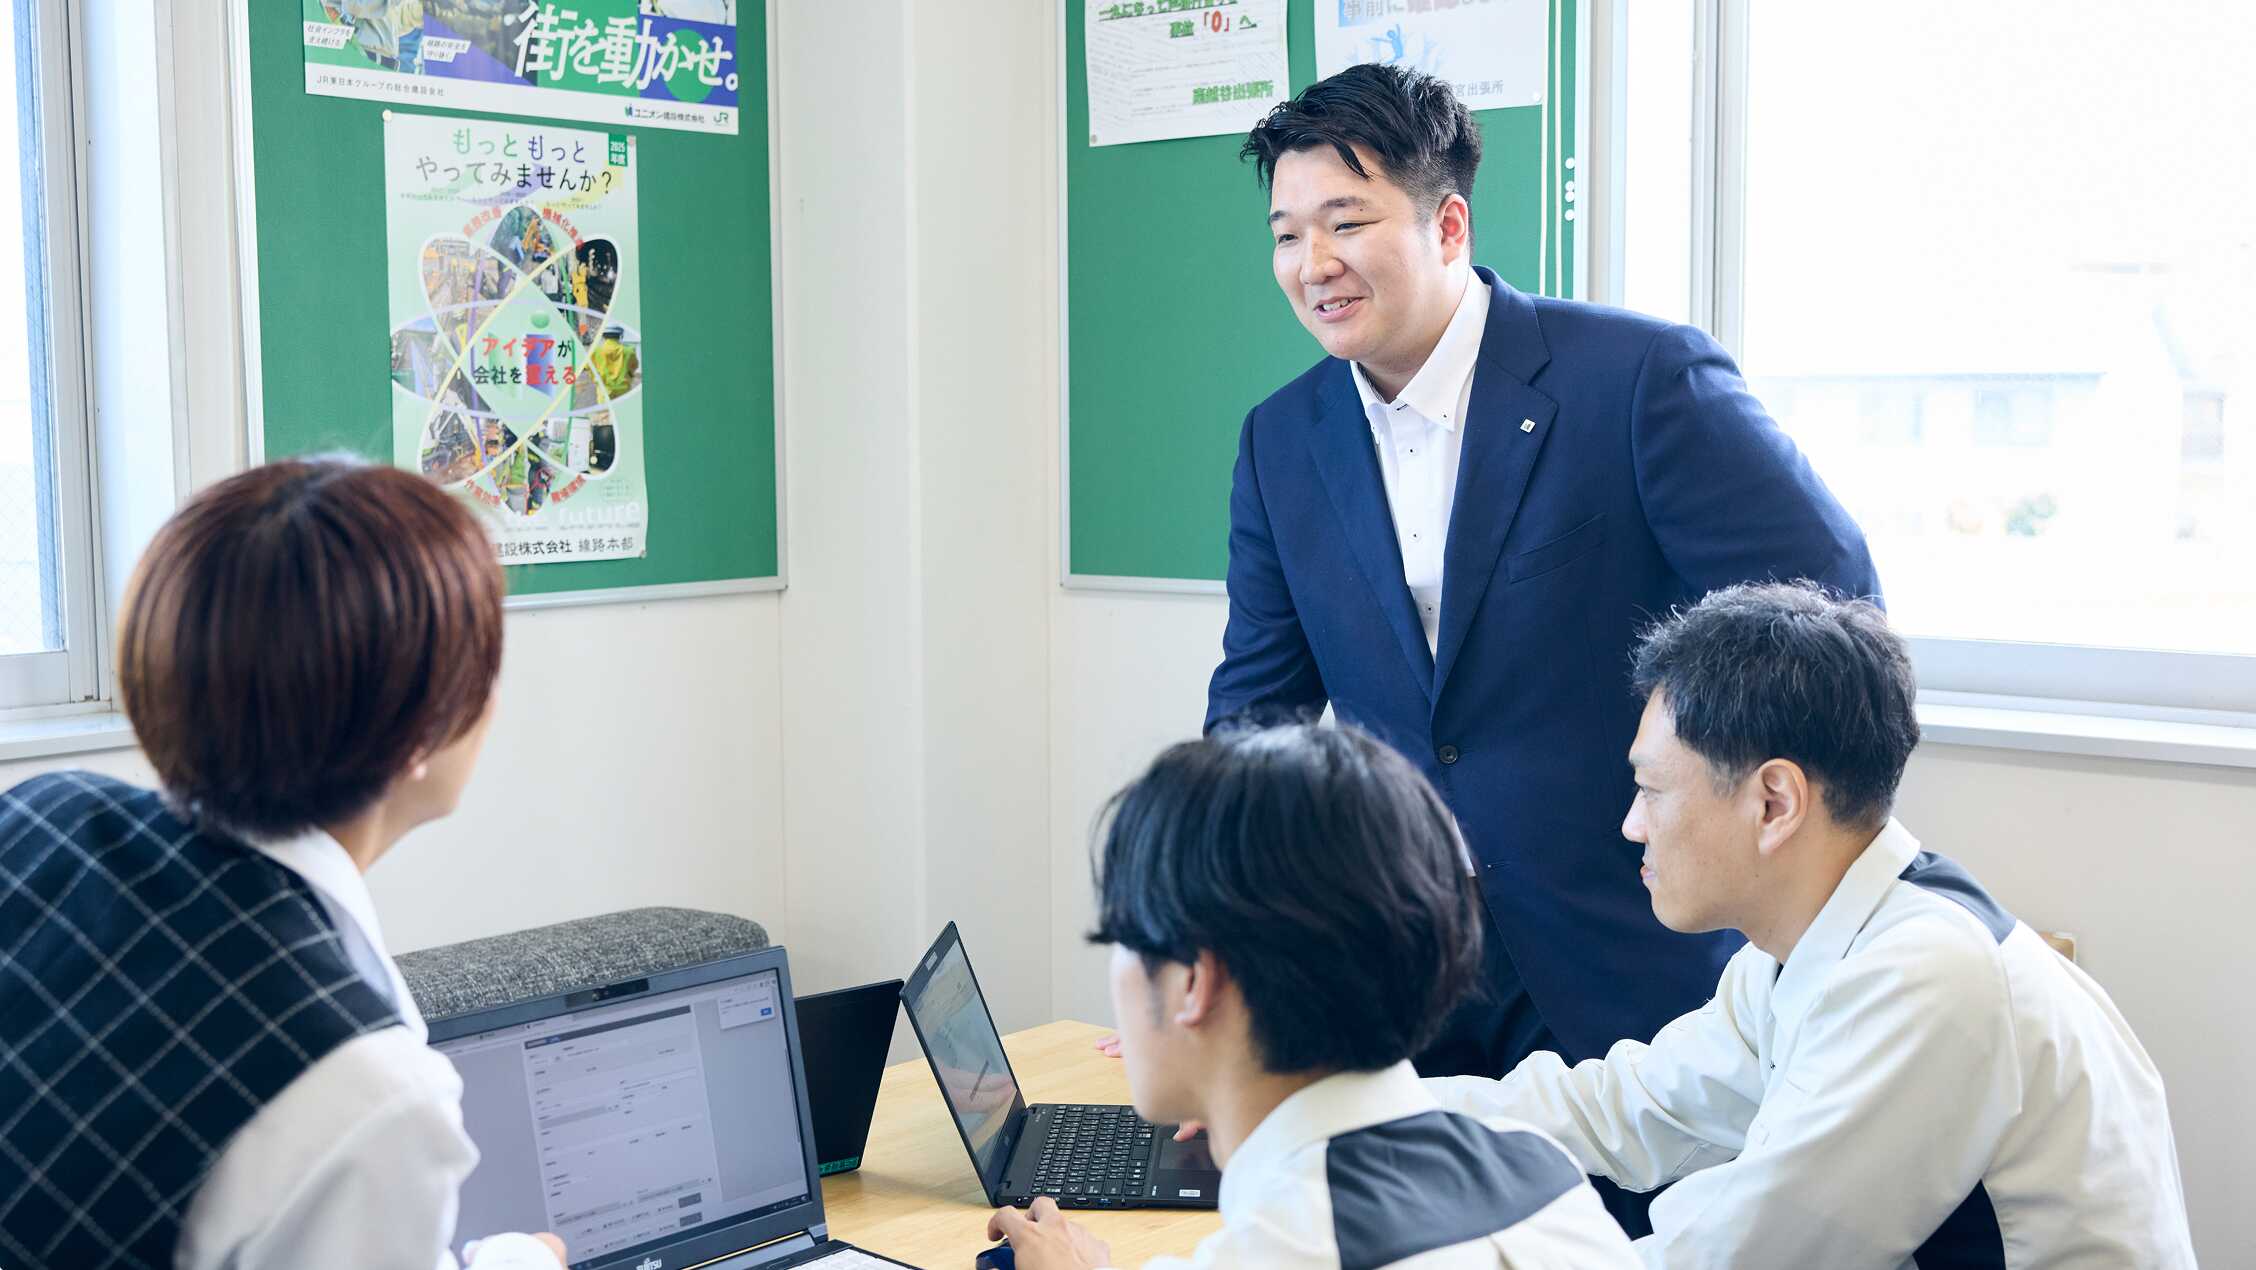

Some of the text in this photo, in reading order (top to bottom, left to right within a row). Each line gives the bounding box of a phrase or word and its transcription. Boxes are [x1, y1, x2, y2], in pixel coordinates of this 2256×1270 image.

[513, 2, 738, 91] 街を動かせ。
[713, 111, 729, 123] JR
[453, 127, 586, 164] もっと もっと
[415, 156, 613, 195] やってみませんか？
[481, 336, 573, 358] アイデアが
